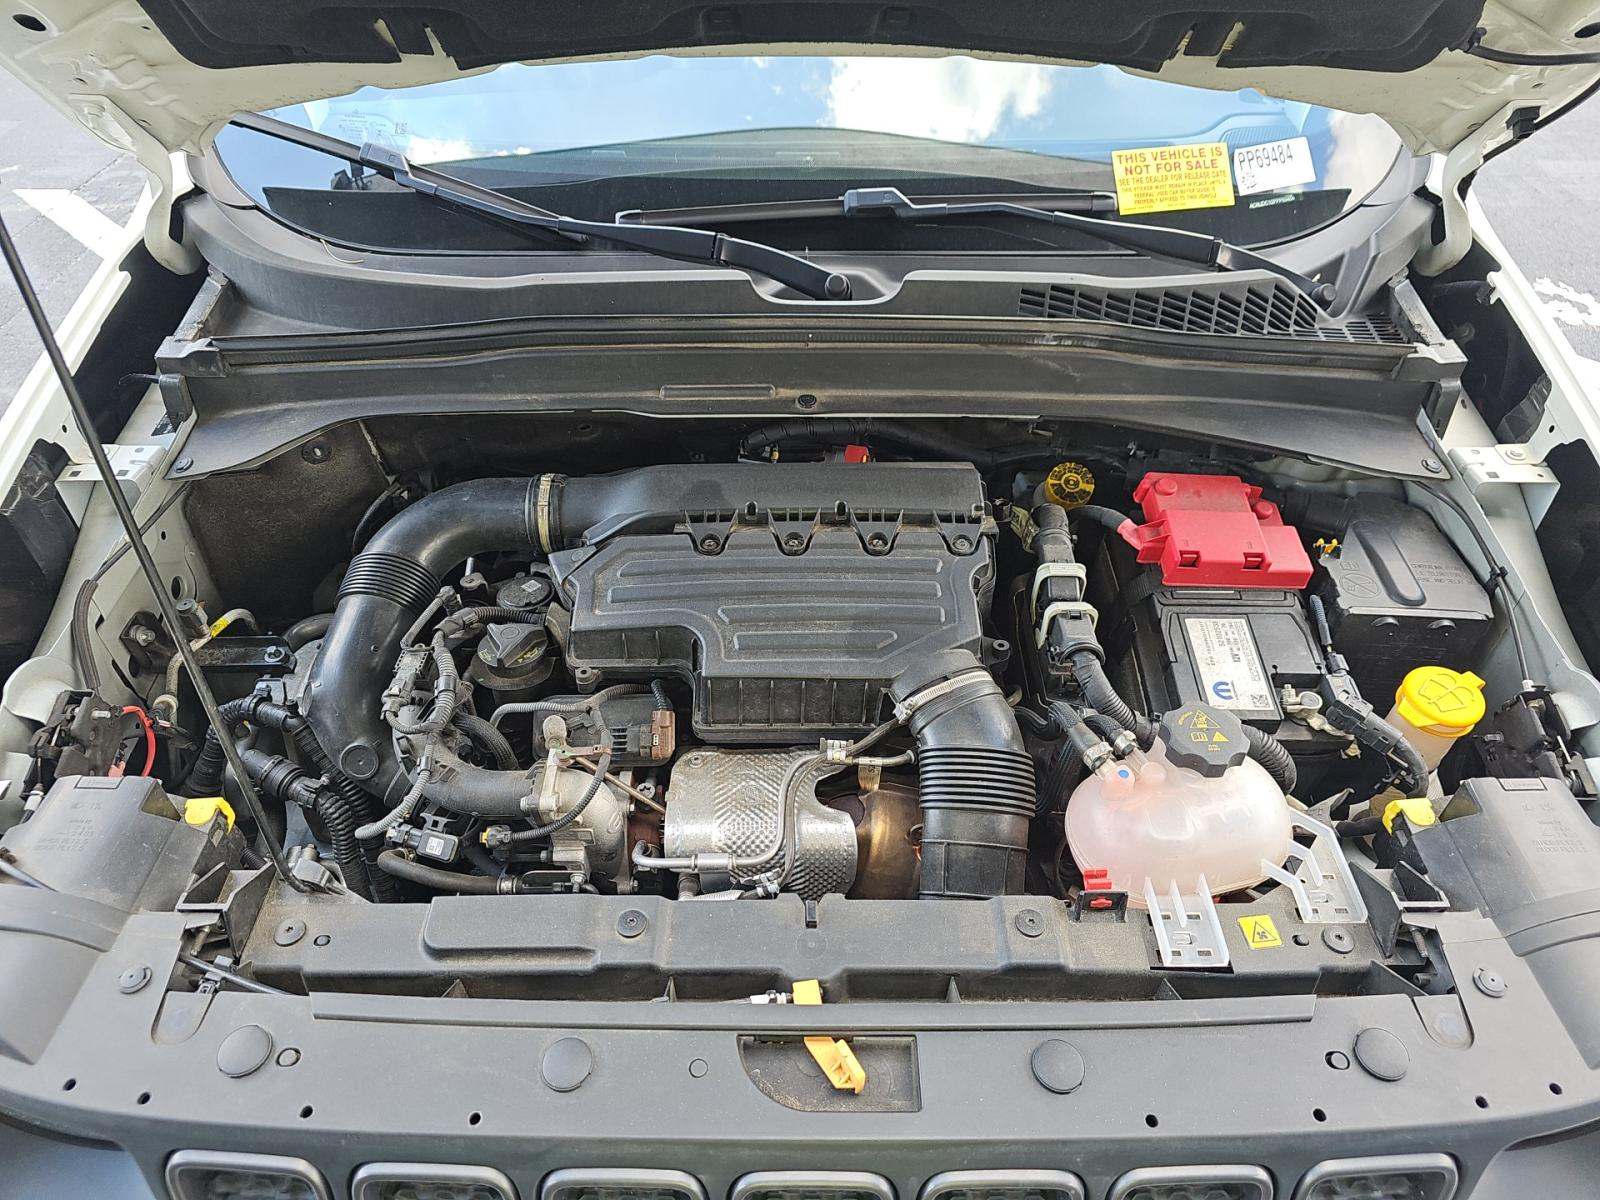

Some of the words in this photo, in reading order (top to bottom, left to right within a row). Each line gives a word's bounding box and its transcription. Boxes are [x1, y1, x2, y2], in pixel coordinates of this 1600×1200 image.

[1116, 152, 1146, 163] THIS
[1151, 148, 1206, 161] VEHICLE
[1210, 146, 1222, 156] IS
[1238, 144, 1294, 171] PP69484
[1124, 164, 1151, 175] NOT
[1156, 162, 1181, 172] FOR
[1186, 159, 1218, 170] SALE
[1145, 175, 1168, 183] DEALER
[1184, 171, 1209, 180] RELEASE
